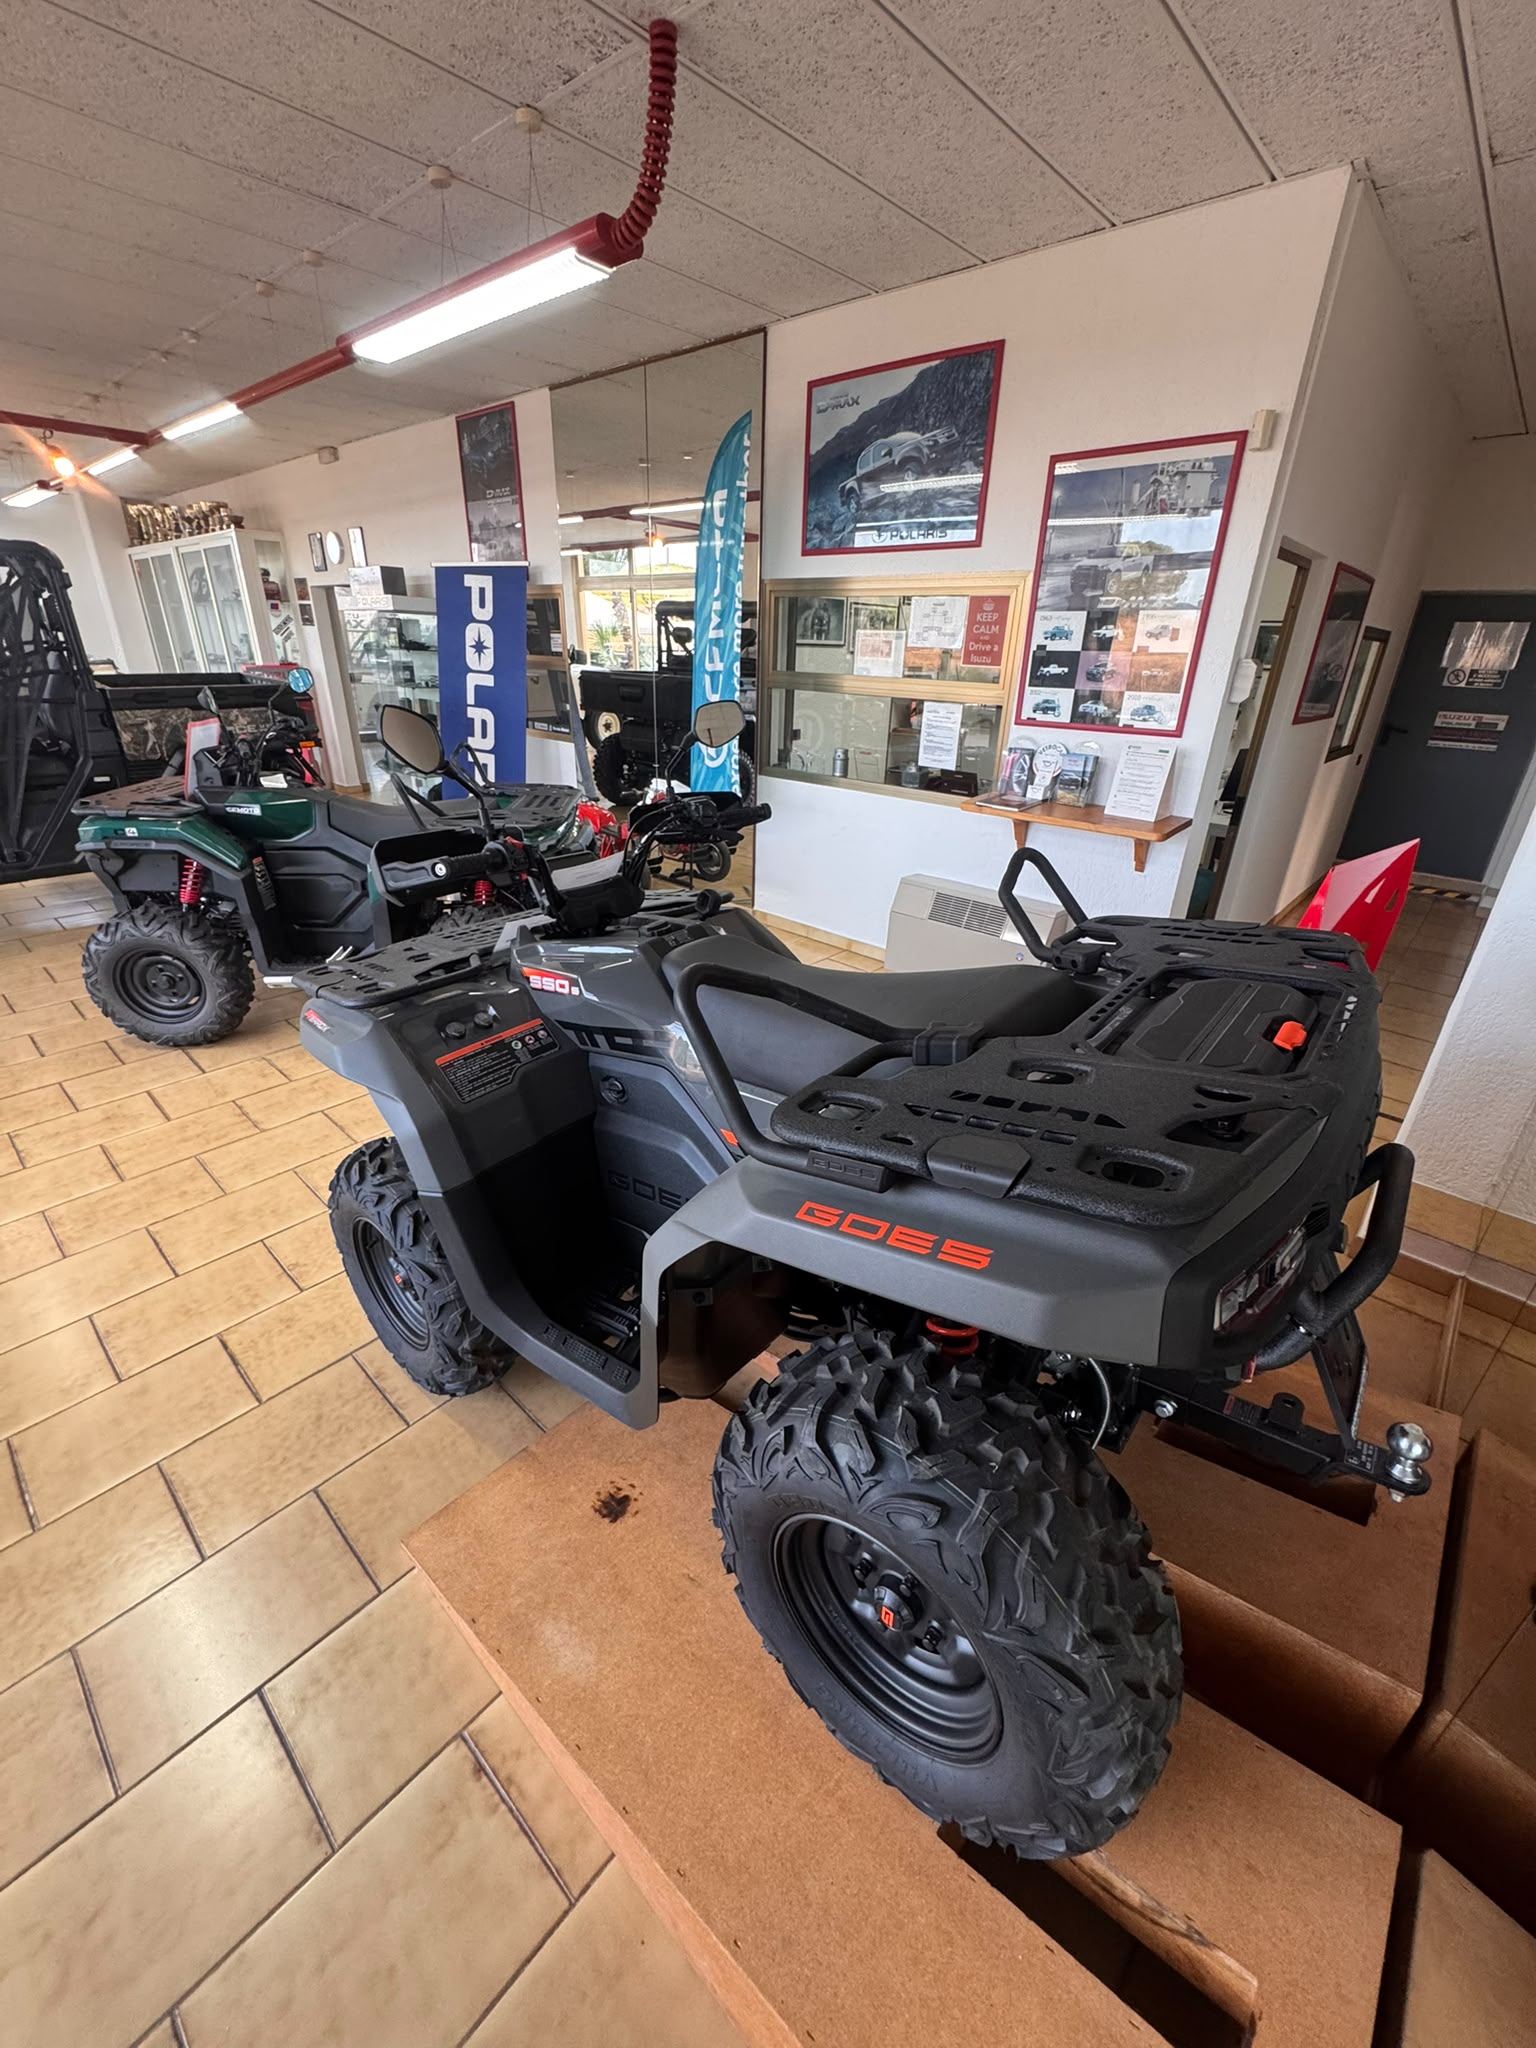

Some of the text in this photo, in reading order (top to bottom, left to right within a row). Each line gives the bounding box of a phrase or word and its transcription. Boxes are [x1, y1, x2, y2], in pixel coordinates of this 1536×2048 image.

[976, 612, 999, 622] KEEP
[972, 624, 1000, 634] CALM
[969, 641, 999, 652] Drive a
[970, 653, 992, 664] Isuzu
[1438, 713, 1471, 721] ISUZU
[812, 1157, 878, 1182] GOES
[608, 1169, 690, 1211] GOE
[795, 1200, 995, 1270] GOES
